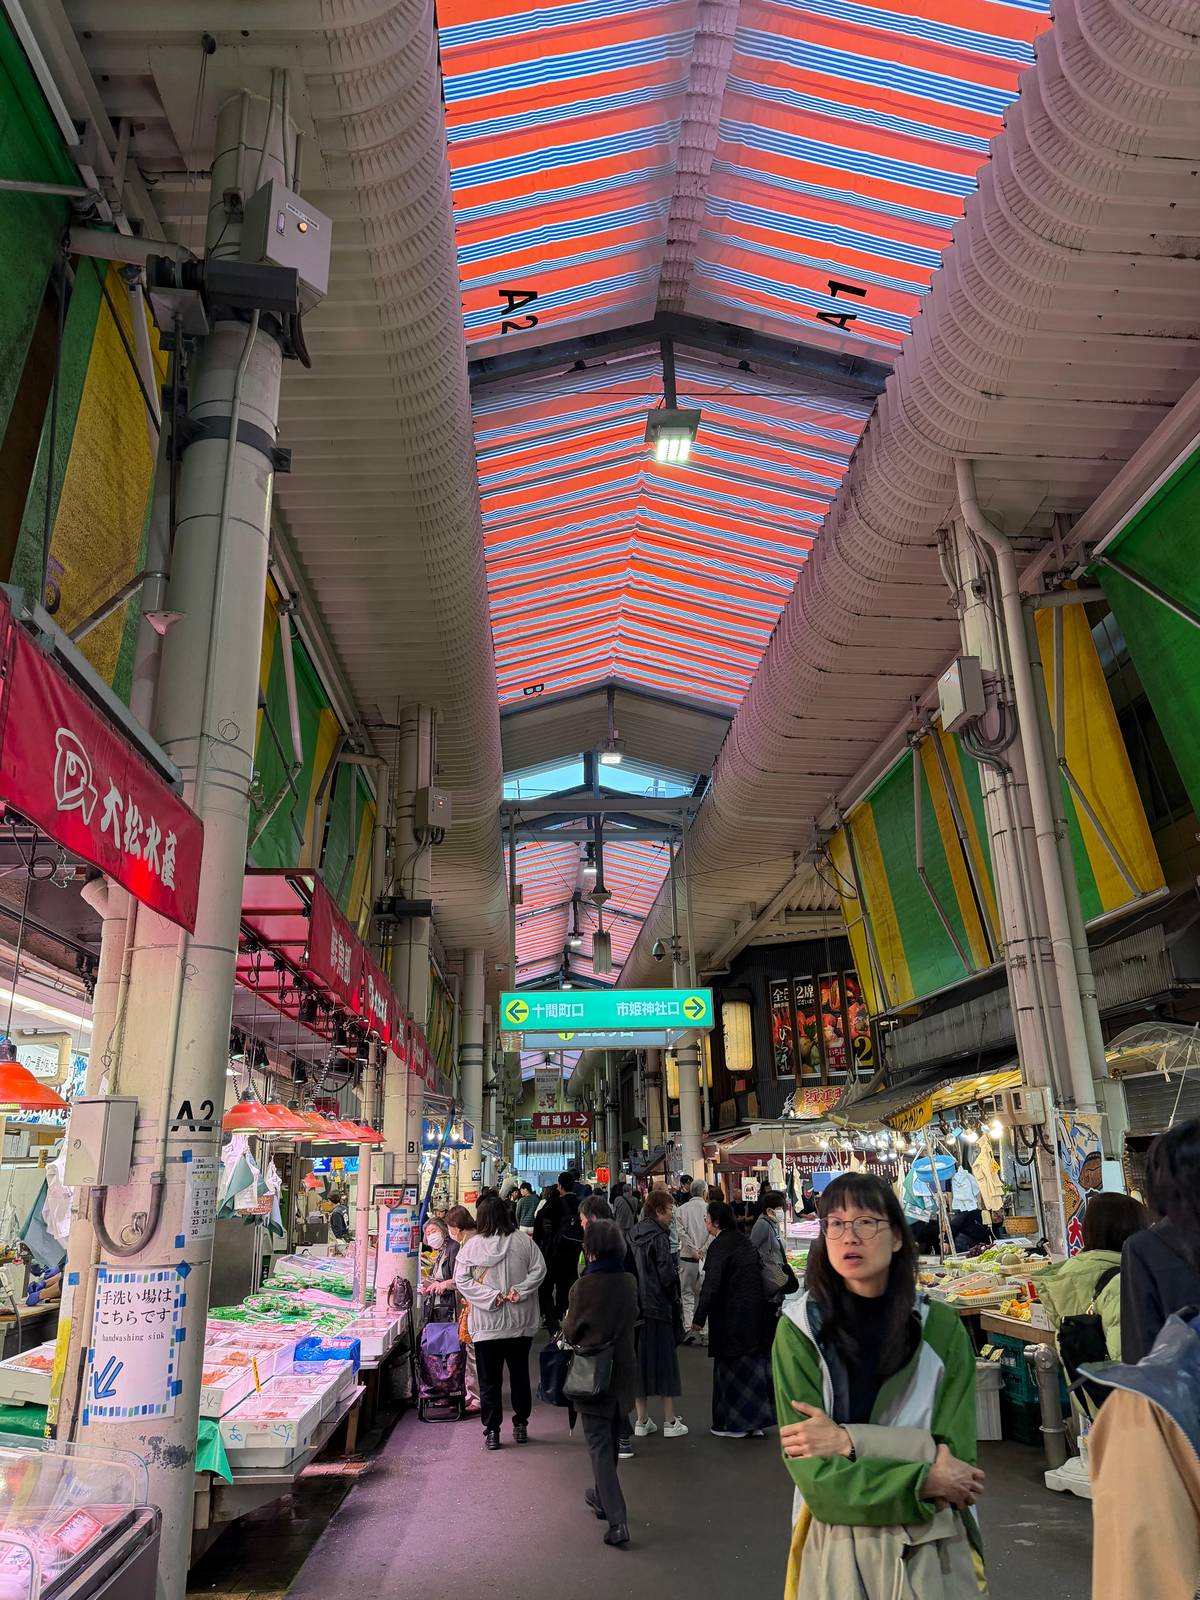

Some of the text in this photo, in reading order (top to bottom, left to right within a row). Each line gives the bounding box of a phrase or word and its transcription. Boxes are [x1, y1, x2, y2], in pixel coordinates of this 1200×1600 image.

[498, 289, 539, 335] A2
[100, 775, 178, 892] 大松水産
[531, 1003, 584, 1019] 十間町口
[616, 1001, 680, 1018] 市姫神社口
[171, 1100, 214, 1132] A2
[101, 1287, 173, 1306] 手洗い場は
[100, 1307, 172, 1326] こちらです
[102, 1331, 165, 1342] handwashing sink
